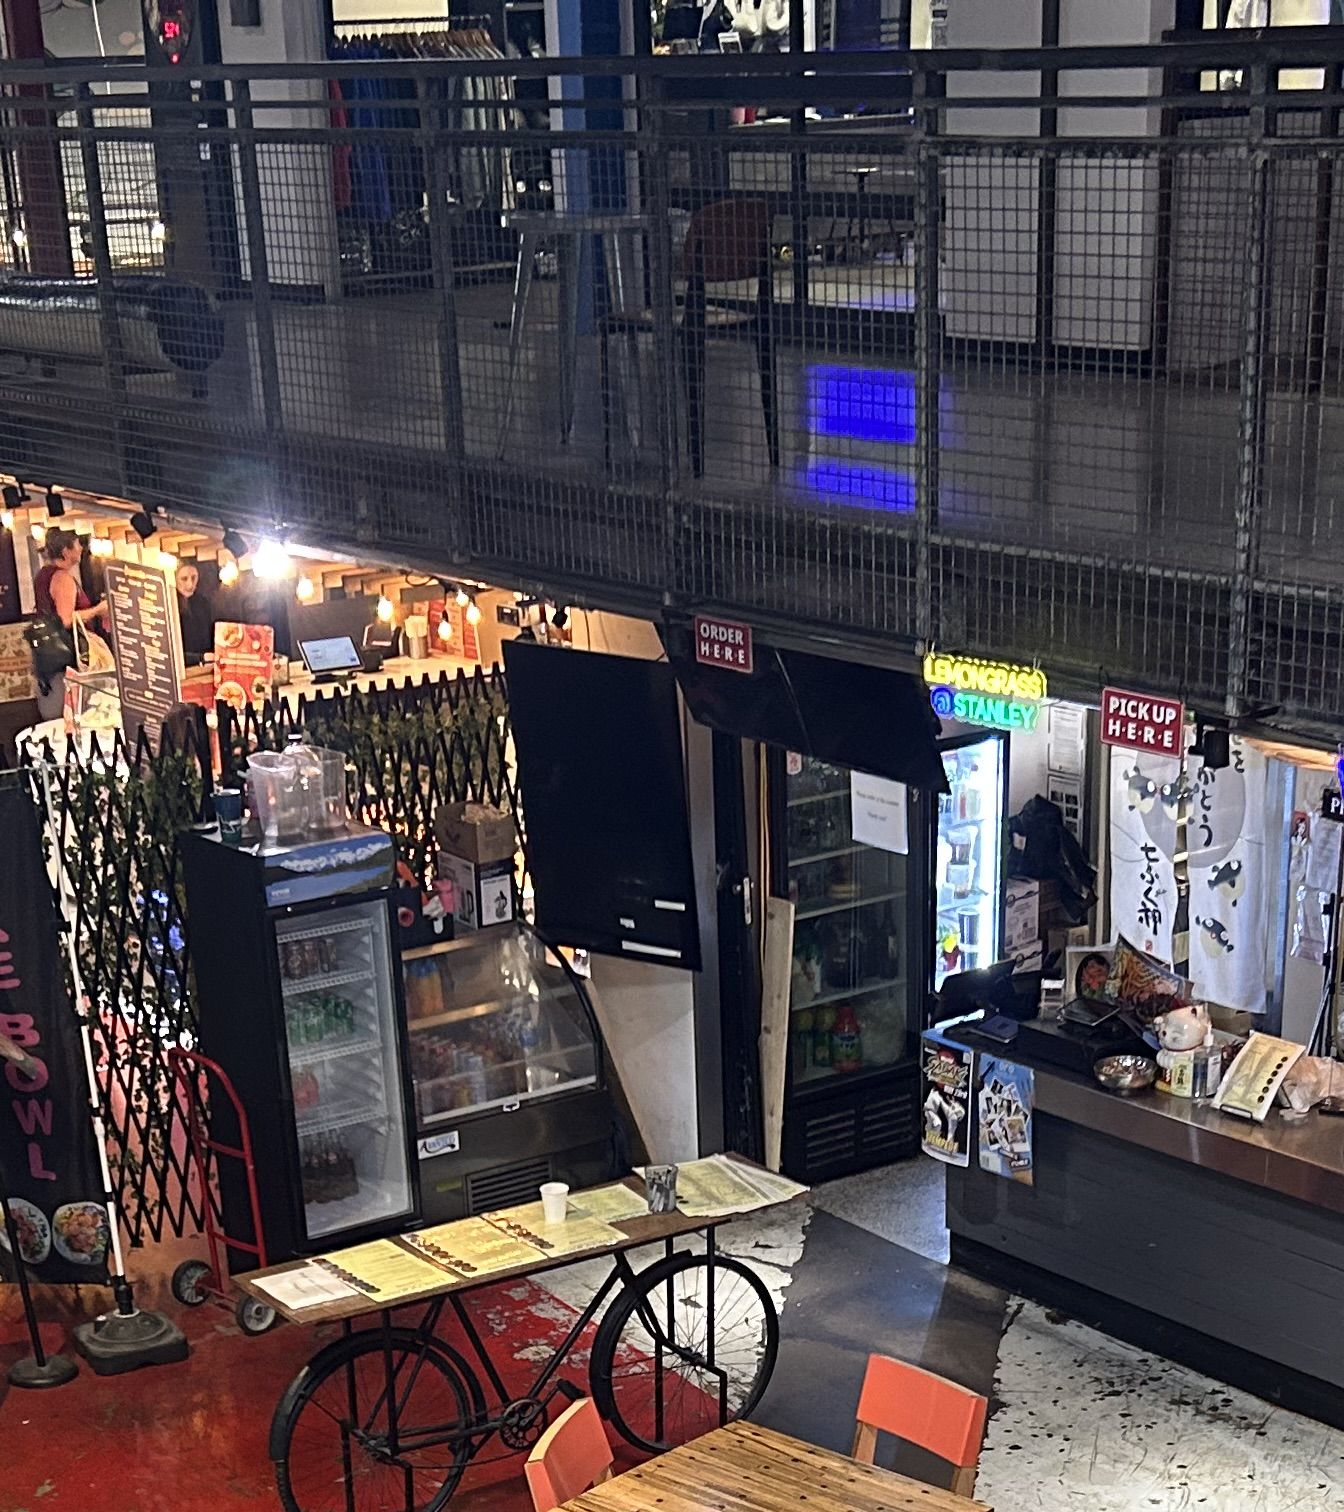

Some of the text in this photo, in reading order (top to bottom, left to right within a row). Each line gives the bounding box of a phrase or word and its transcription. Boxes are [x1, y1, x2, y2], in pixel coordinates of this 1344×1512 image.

[700, 622, 744, 646] ORDER
[925, 657, 1043, 701] LEMONGRASS
[1108, 696, 1177, 725] PICK UP
